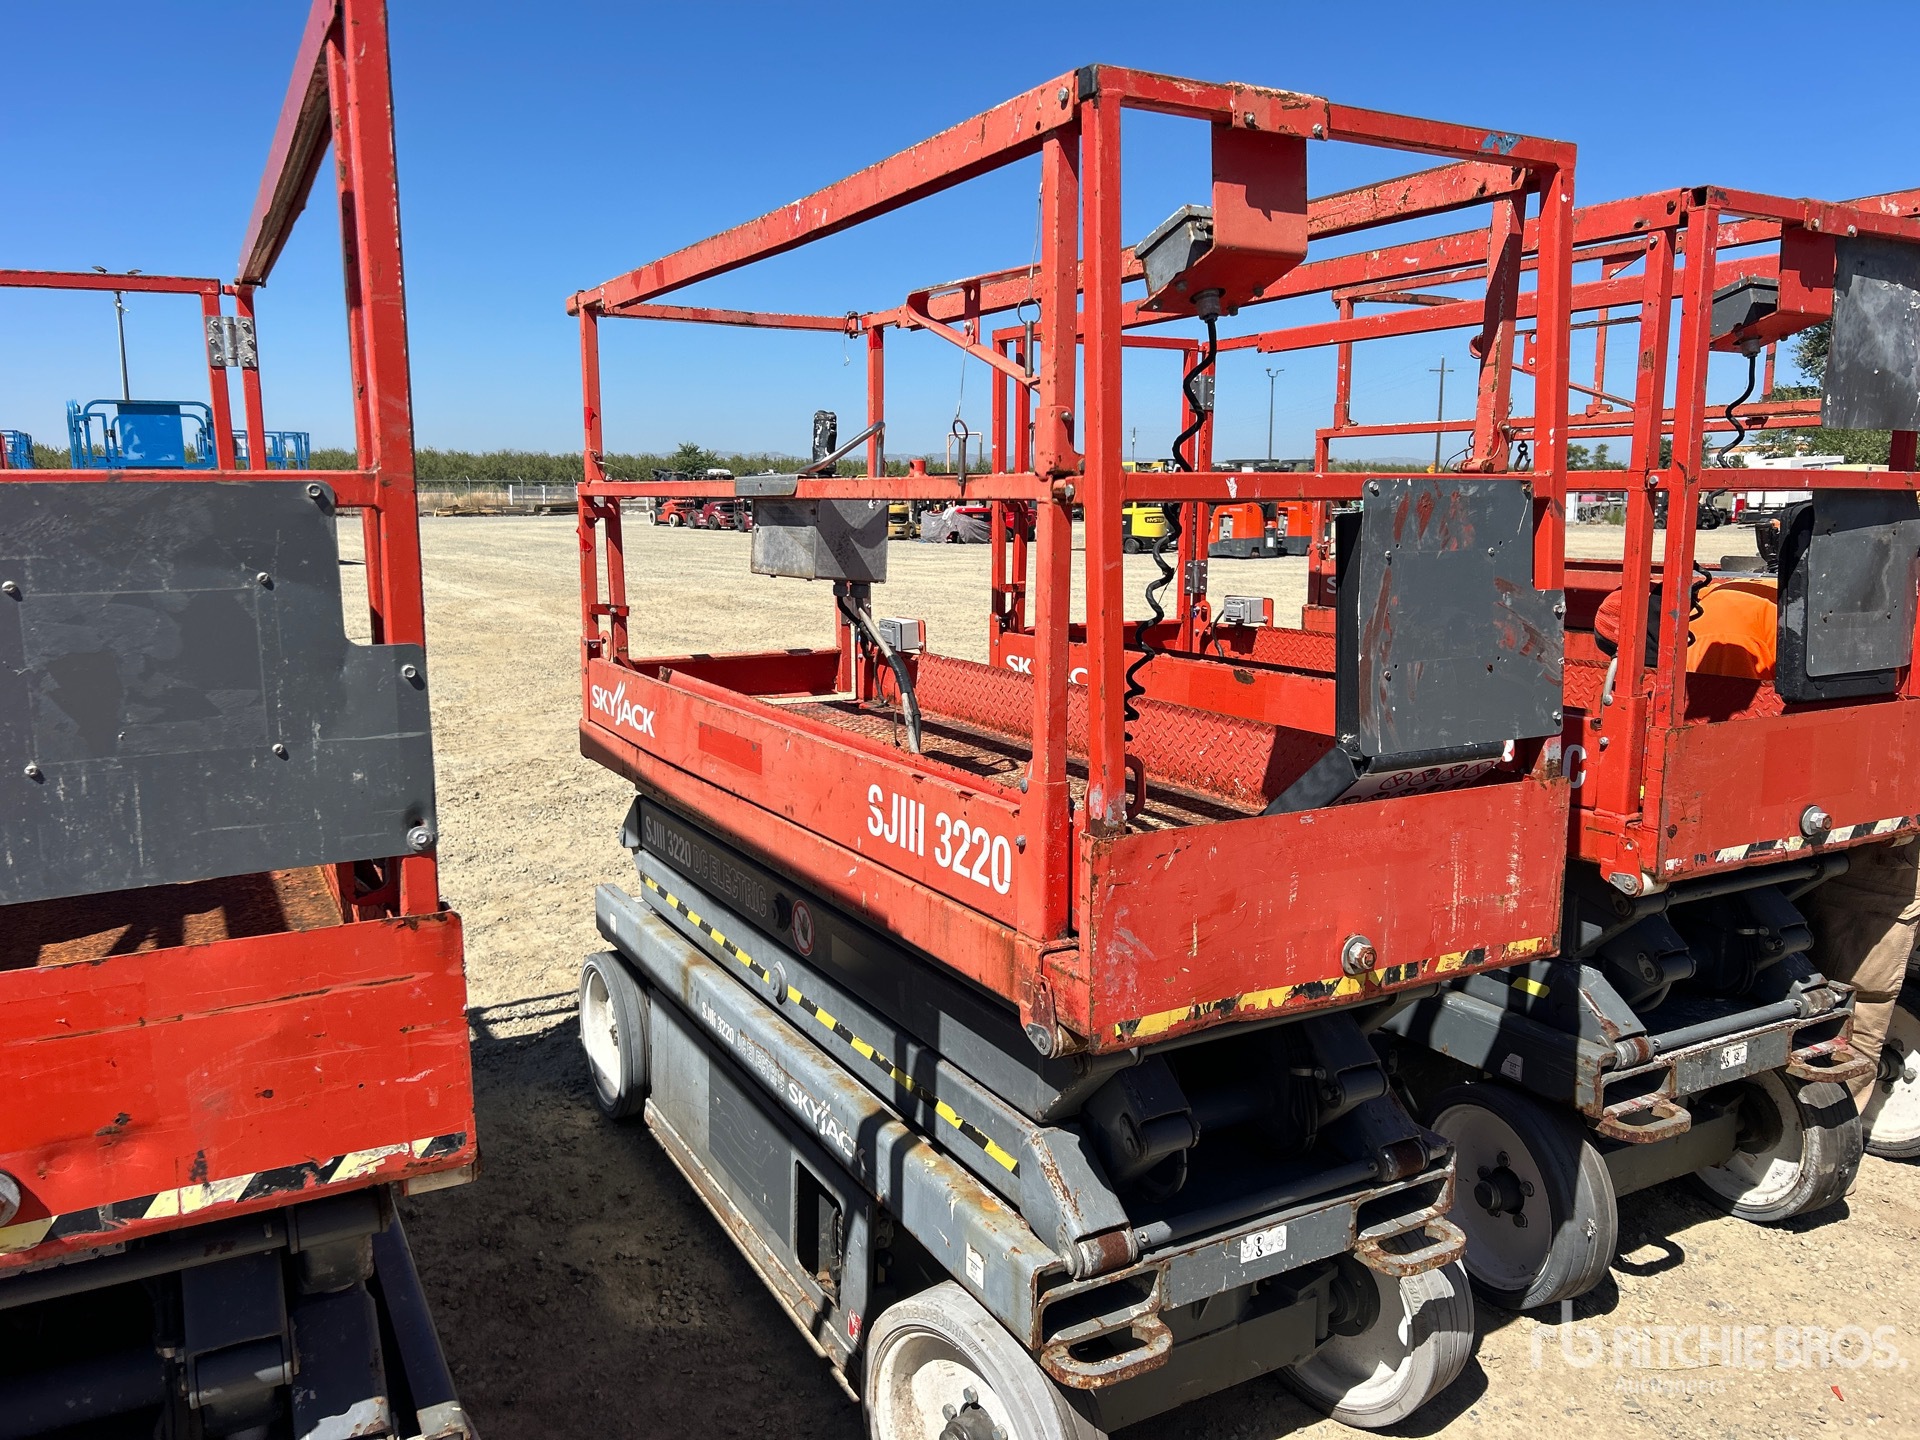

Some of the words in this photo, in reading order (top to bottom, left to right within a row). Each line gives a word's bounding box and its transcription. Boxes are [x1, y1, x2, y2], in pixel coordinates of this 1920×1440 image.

[591, 681, 655, 738] SKYJACK
[645, 816, 666, 852] SJIII
[667, 830, 692, 868] 3220
[692, 844, 708, 878] DC
[709, 854, 767, 917] ELECTRIC
[867, 784, 925, 857] SJIII
[934, 812, 1012, 894] 3220
[717, 1015, 735, 1045] 3220
